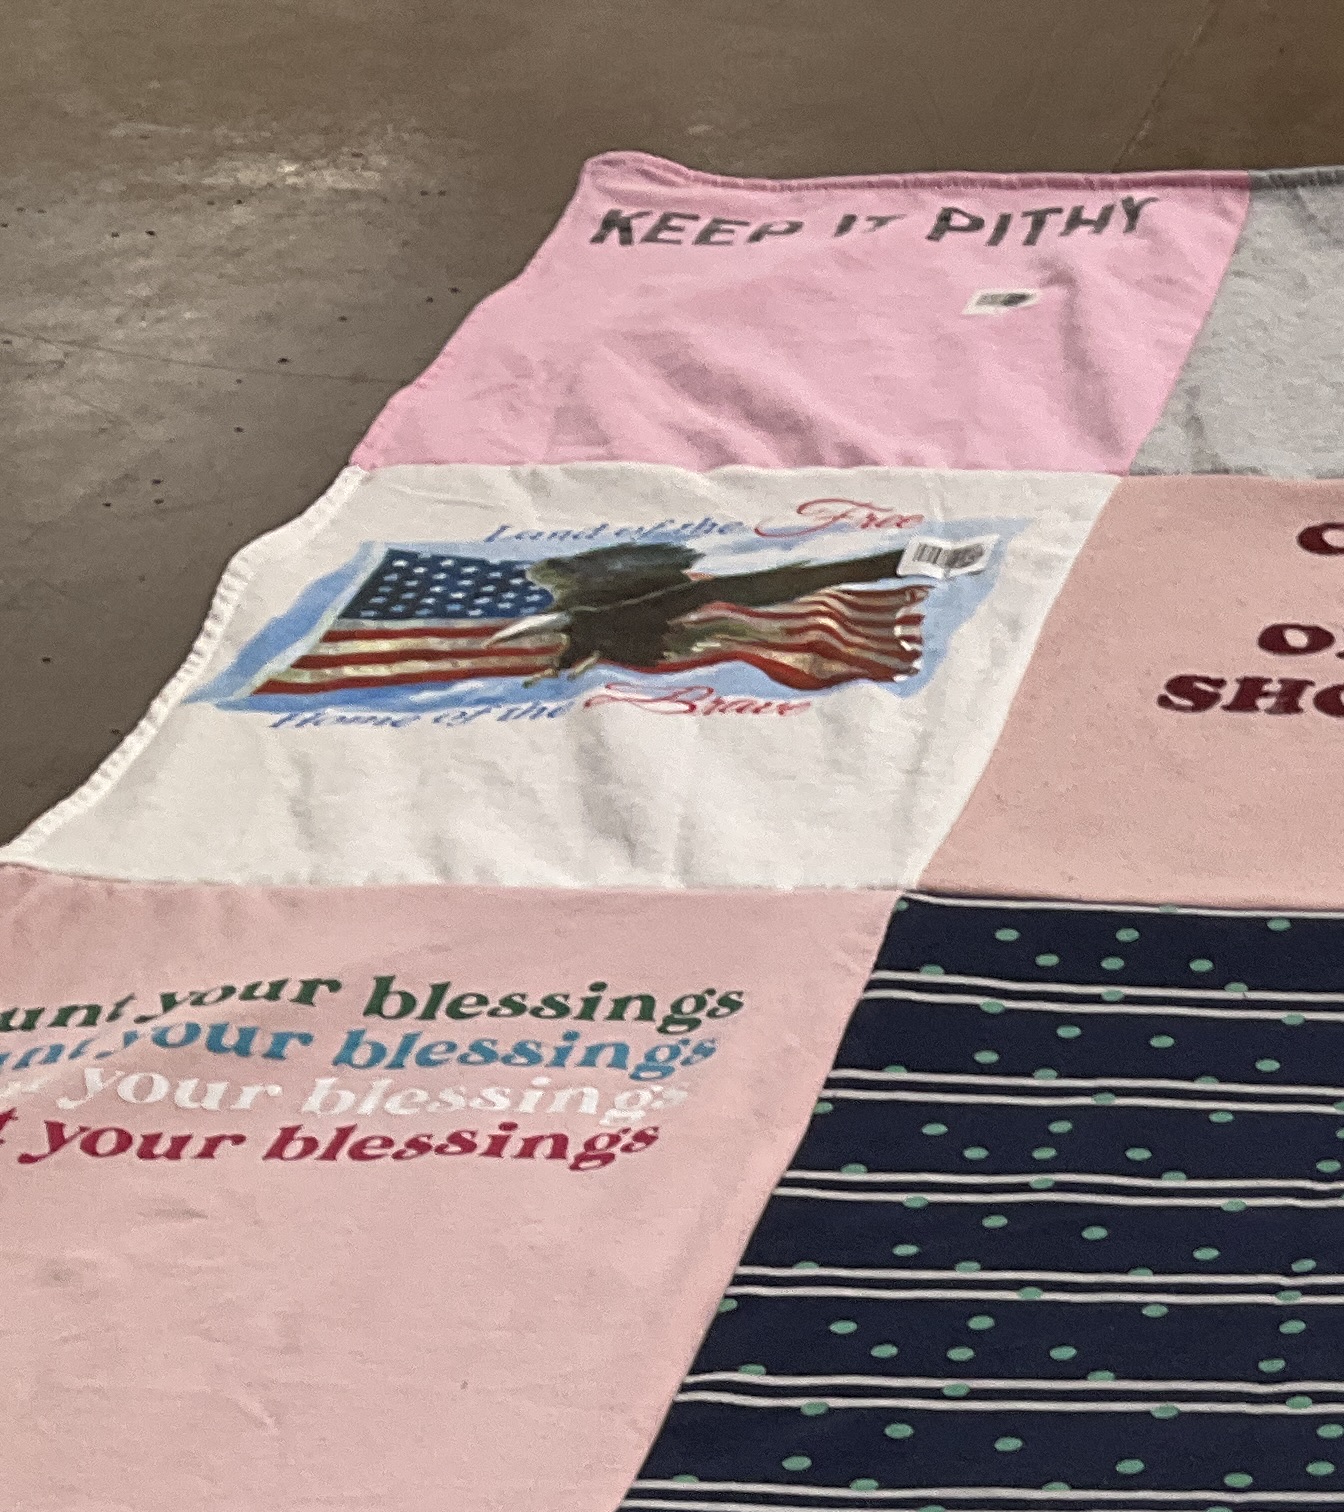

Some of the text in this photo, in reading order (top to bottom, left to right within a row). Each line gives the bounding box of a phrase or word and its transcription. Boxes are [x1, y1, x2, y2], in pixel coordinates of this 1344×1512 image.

[588, 207, 804, 247] KEEP
[924, 195, 1160, 248] PITHY
[483, 522, 609, 544] Land
[753, 497, 926, 540] Free
[133, 977, 343, 1024] your
[361, 974, 746, 1036] blessings
[331, 1027, 718, 1082] blessings
[56, 1066, 284, 1112] your
[299, 1075, 691, 1128] blessings
[16, 1119, 248, 1165] your
[261, 1120, 662, 1172] blessings
